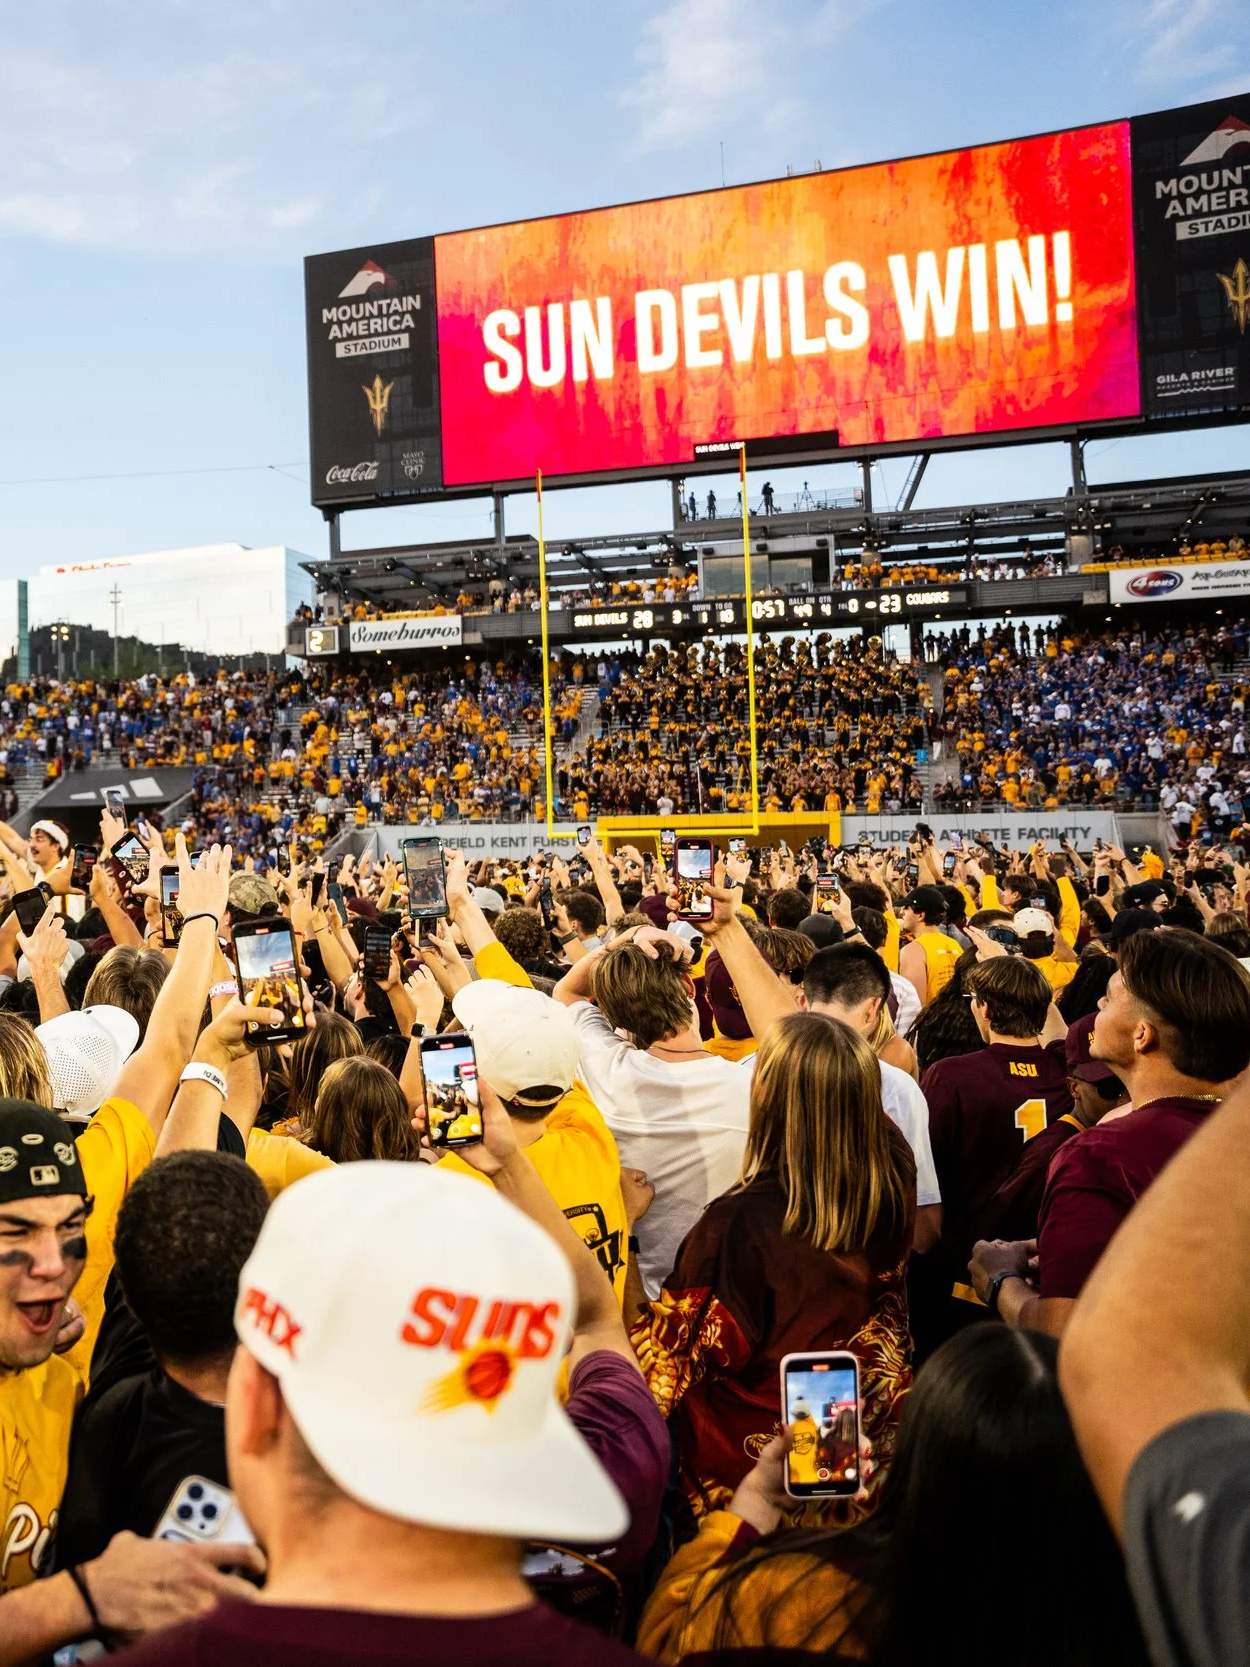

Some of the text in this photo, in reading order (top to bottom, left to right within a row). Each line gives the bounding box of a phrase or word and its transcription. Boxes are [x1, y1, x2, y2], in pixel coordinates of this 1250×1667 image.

[1155, 164, 1250, 199] MOUN
[322, 294, 421, 324] MOUNTAIN
[483, 230, 1074, 393] SUN DEVILS WIN!
[328, 313, 415, 340] AMERICA
[344, 336, 402, 355] STADIUM
[1156, 372, 1189, 384] GILA
[1191, 367, 1234, 380] RIVER
[400, 458, 425, 466] CLINIC
[402, 451, 424, 459] MAYO
[326, 461, 380, 485] Coca-Cola
[692, 603, 711, 612] DOWN
[751, 599, 832, 619] 0:57 49 4
[848, 598, 859, 614] 0
[879, 591, 950, 614] 23 COUGARS
[574, 610, 654, 629] SUN DEVILS 28
[672, 609, 683, 625] 3
[720, 609, 734, 624] 10
[351, 622, 461, 644] Someburros
[490, 836, 527, 848] KENT
[857, 830, 916, 843] STUDE
[1009, 1061, 1038, 1077] ASU
[240, 1286, 304, 1362] PHX
